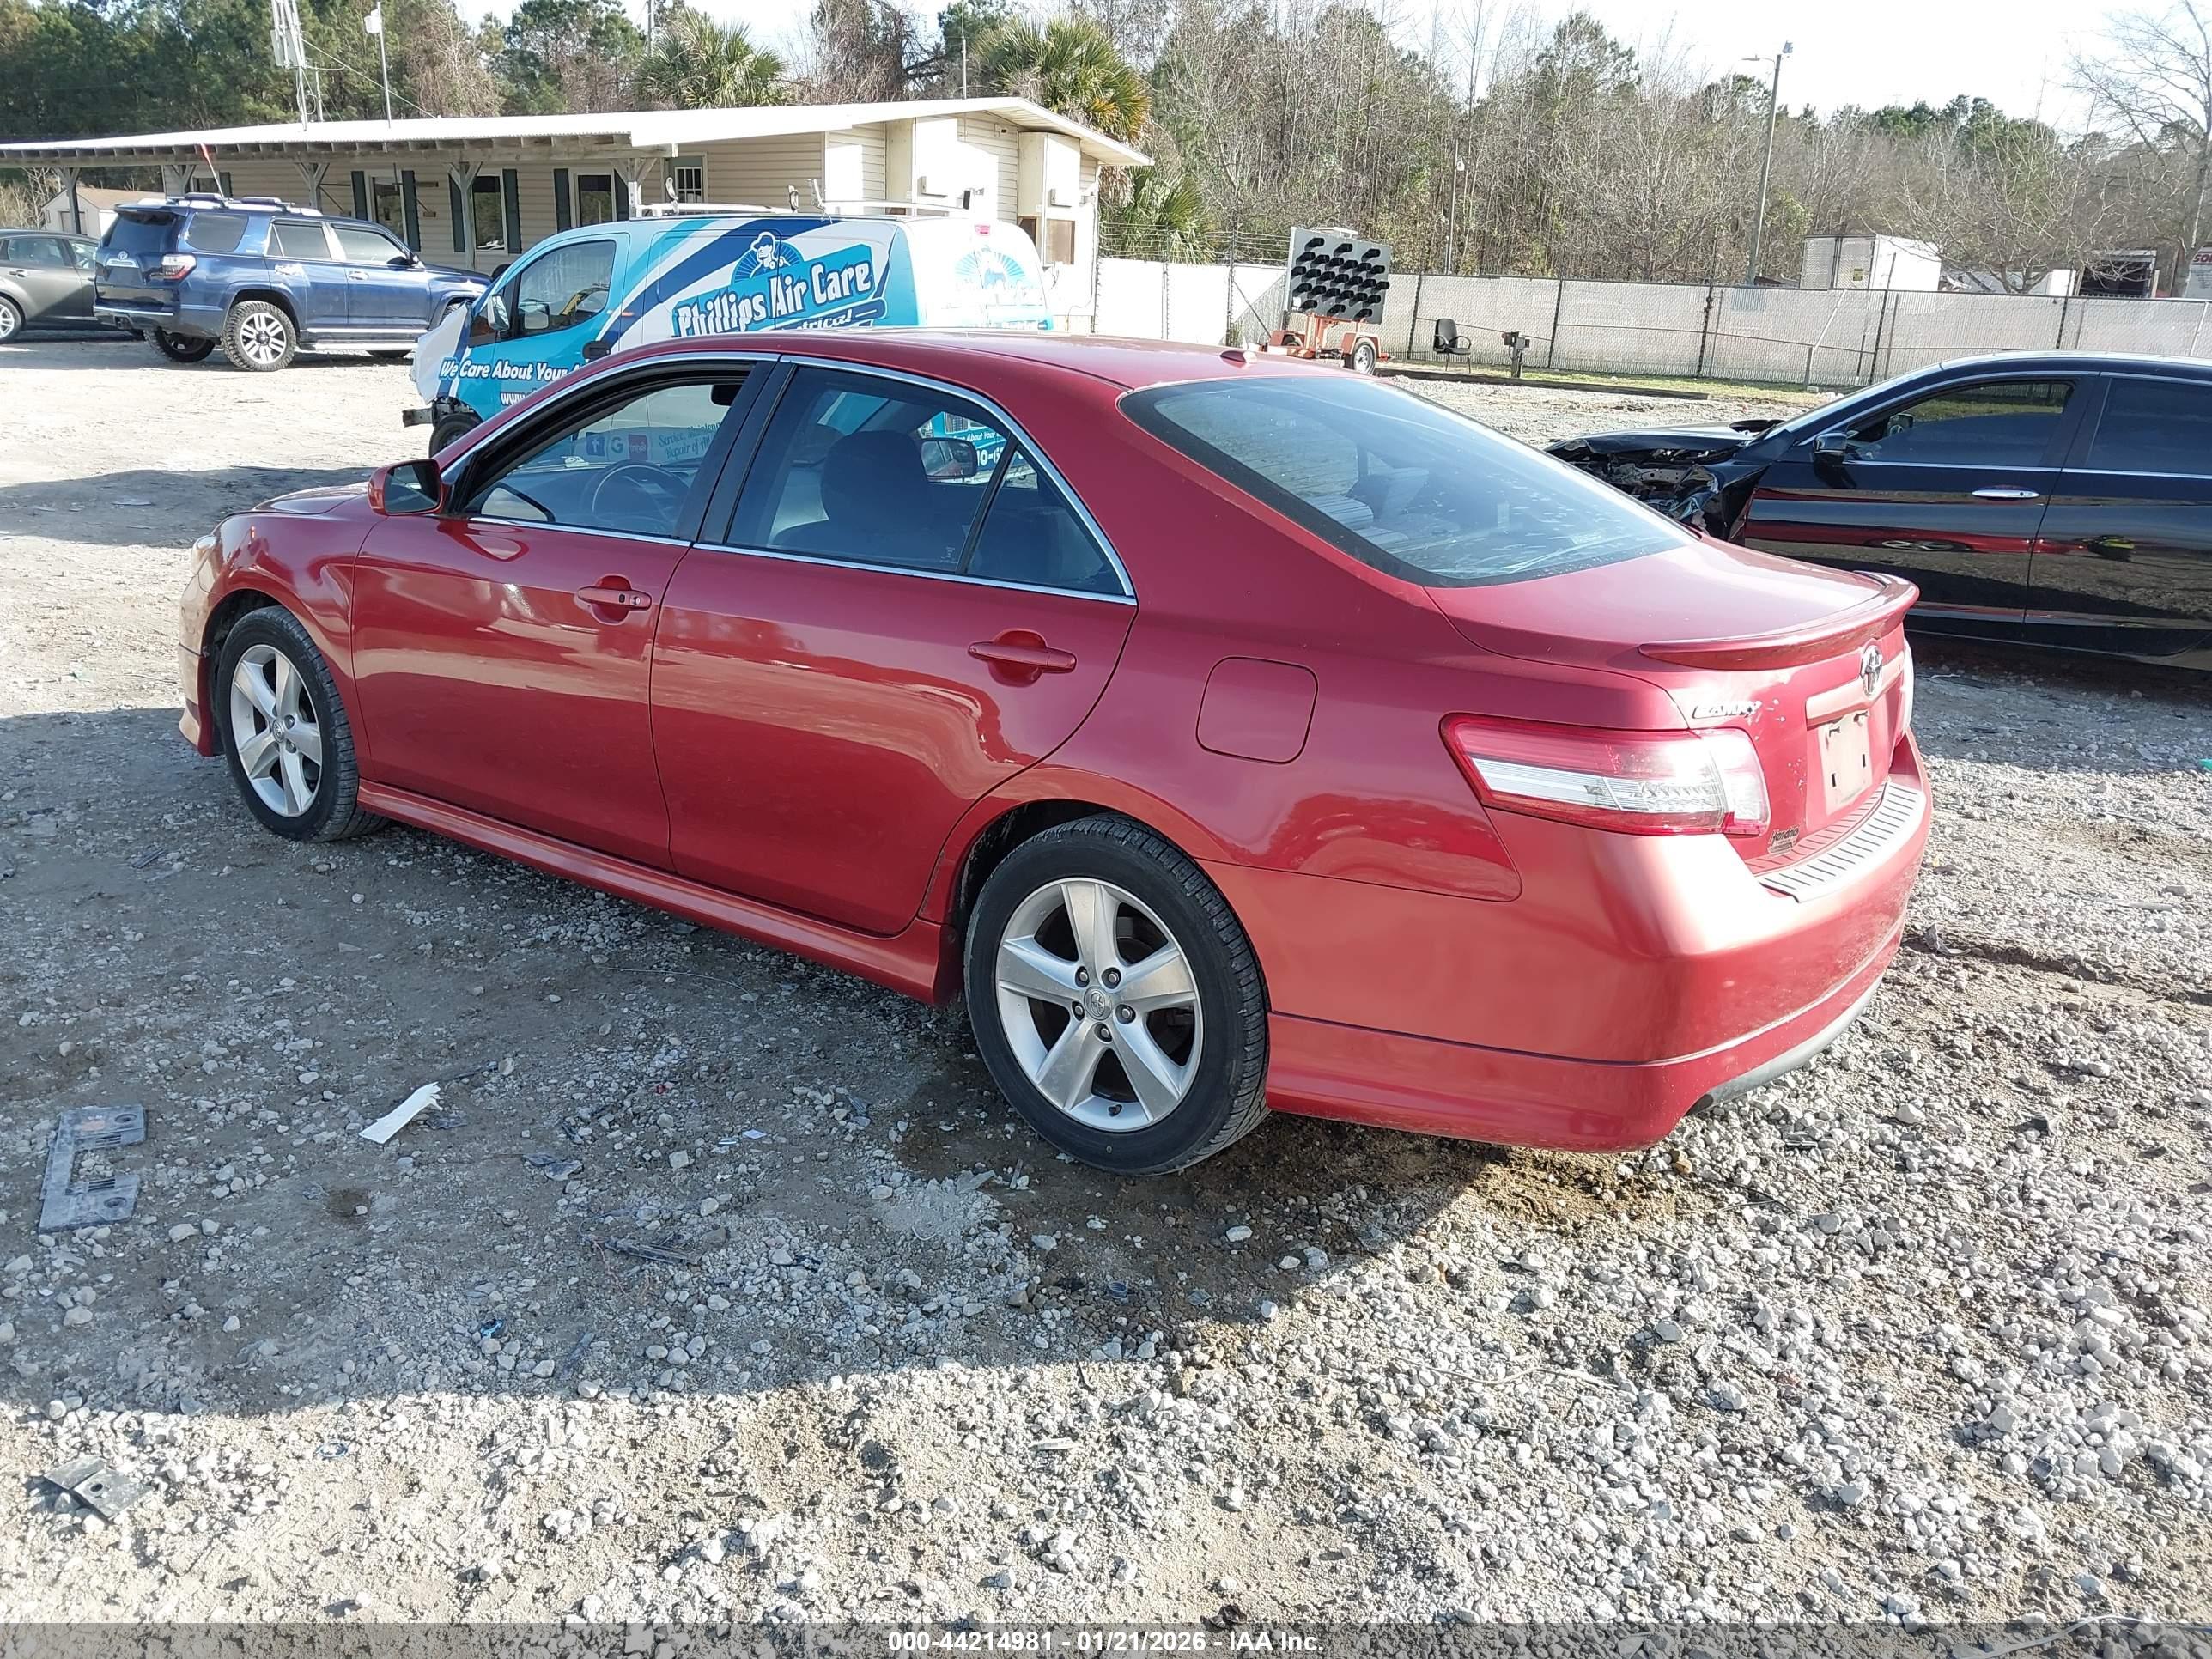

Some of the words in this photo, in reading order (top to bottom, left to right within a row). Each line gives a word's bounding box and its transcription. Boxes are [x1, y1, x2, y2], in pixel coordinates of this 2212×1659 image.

[677, 289, 768, 337] Phillips
[769, 275, 808, 317] Air
[811, 261, 872, 305] Care
[440, 360, 458, 377] We
[459, 360, 491, 379] Care
[491, 361, 534, 380] About
[536, 362, 568, 380] Your
[966, 431, 984, 441] About
